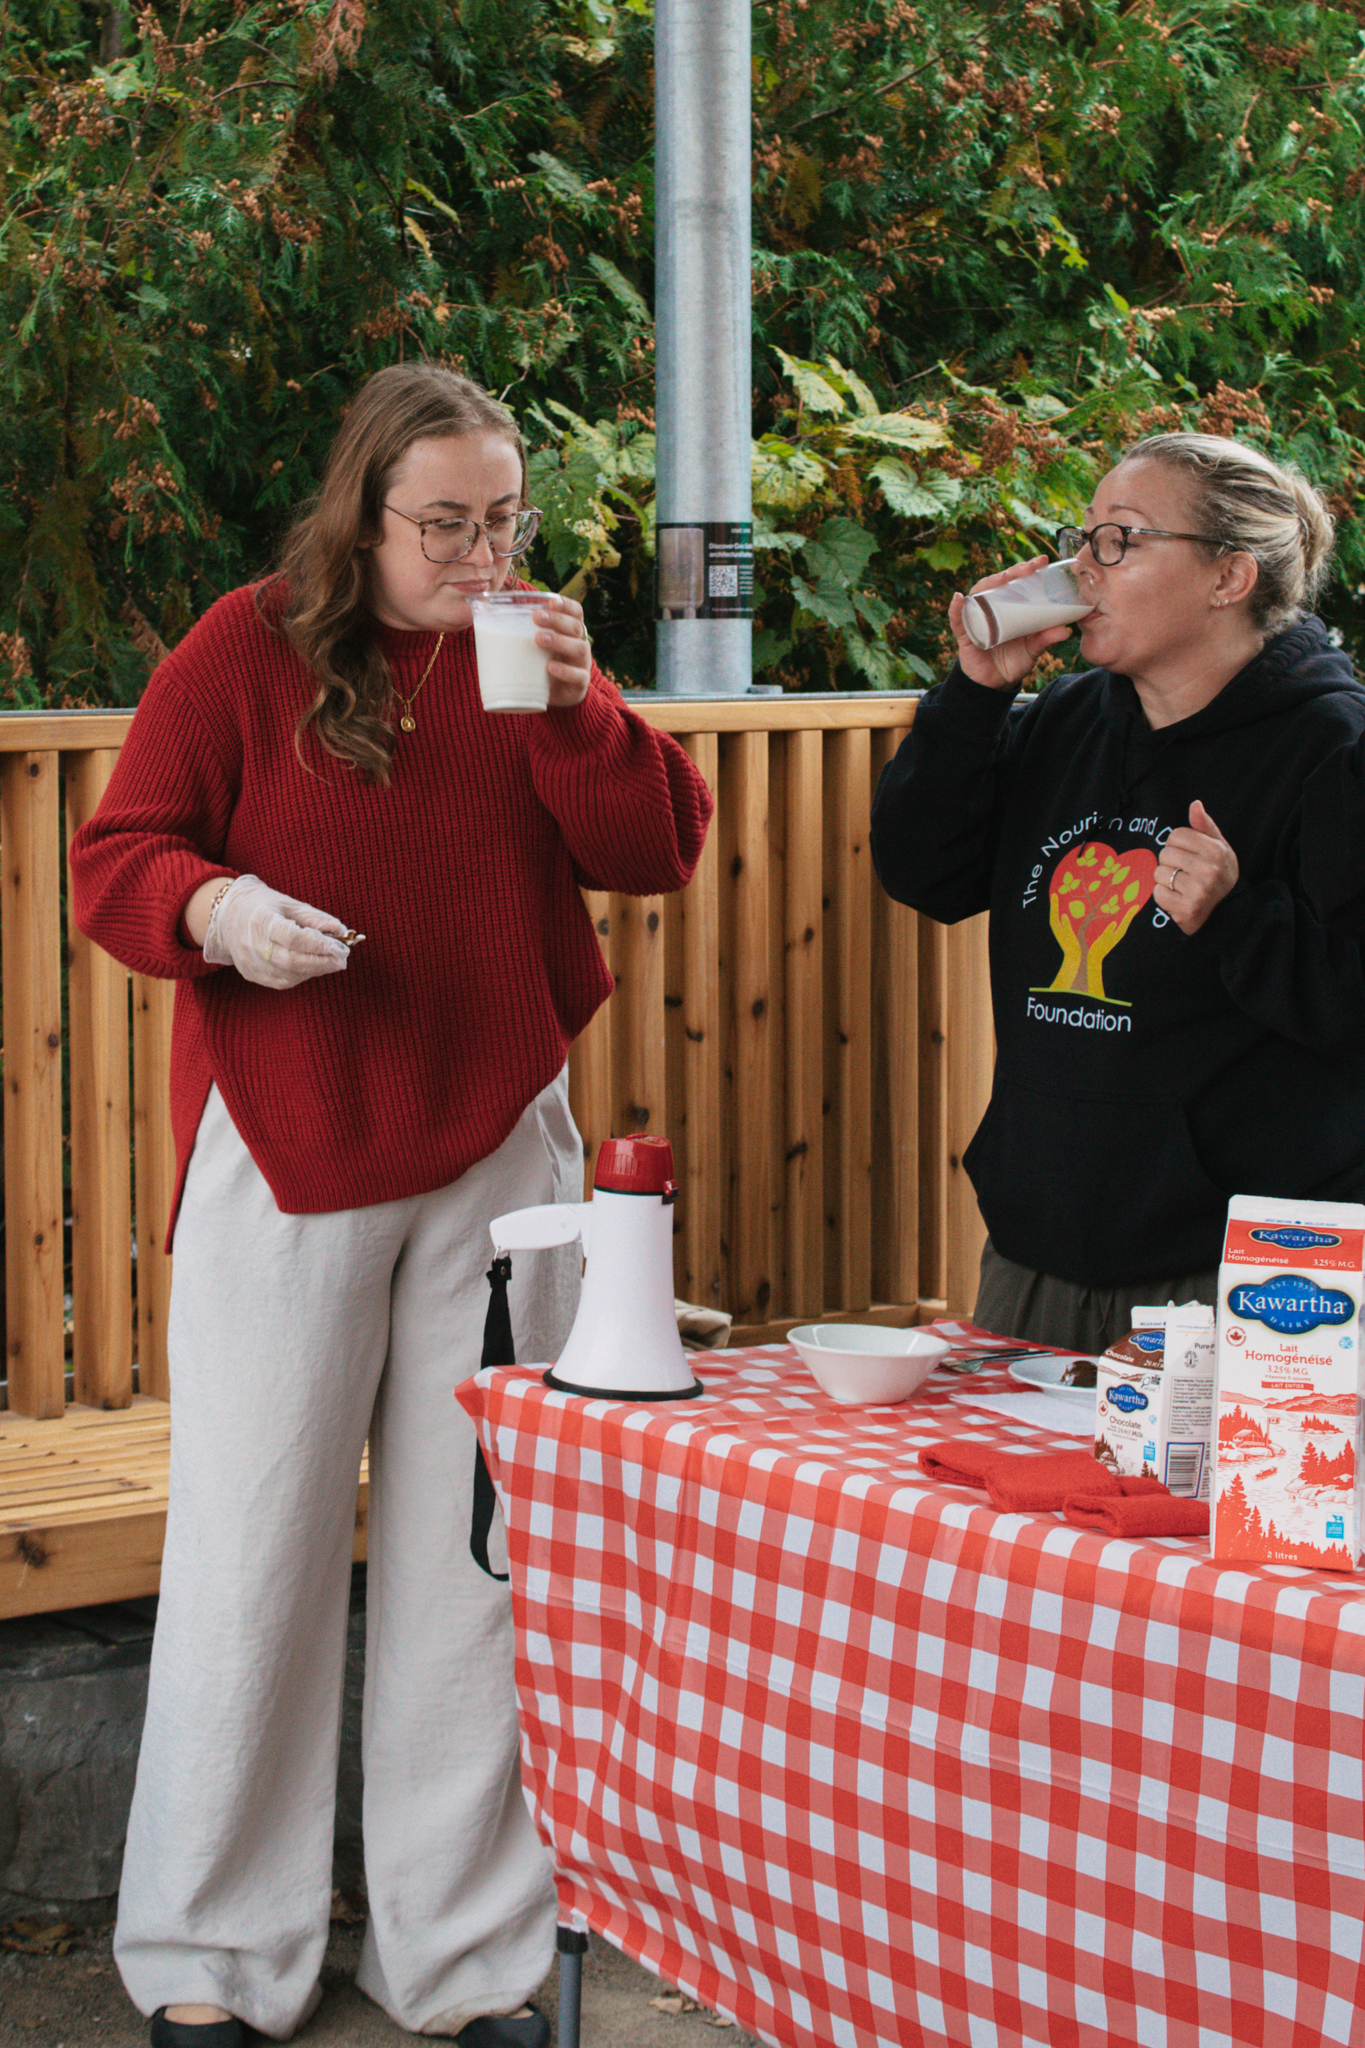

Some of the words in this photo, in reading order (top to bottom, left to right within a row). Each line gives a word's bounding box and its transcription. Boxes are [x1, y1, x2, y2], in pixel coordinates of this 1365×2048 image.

[1022, 863, 1043, 909] The
[1041, 811, 1123, 857] Nourih
[1128, 816, 1159, 836] and
[1027, 996, 1132, 1032] Foundation
[1258, 1231, 1334, 1244] Kawartha
[1227, 1253, 1289, 1264] Homogénéisé
[1313, 1258, 1336, 1267] 3.25%
[1237, 1290, 1346, 1315] Kawartha
[1269, 1316, 1310, 1328] DAIRY
[1194, 1342, 1216, 1350] Pure-P
[1280, 1343, 1298, 1352] Lait
[1105, 1349, 1135, 1363] Chocolate
[1245, 1349, 1333, 1366] Homogénéisé
[1267, 1365, 1291, 1374] 3.25%
[1292, 1367, 1310, 1375] M.G.
[1108, 1389, 1147, 1406] Kawartha
[1109, 1415, 1141, 1430] Chocolate
[1274, 1551, 1298, 1561] litres
